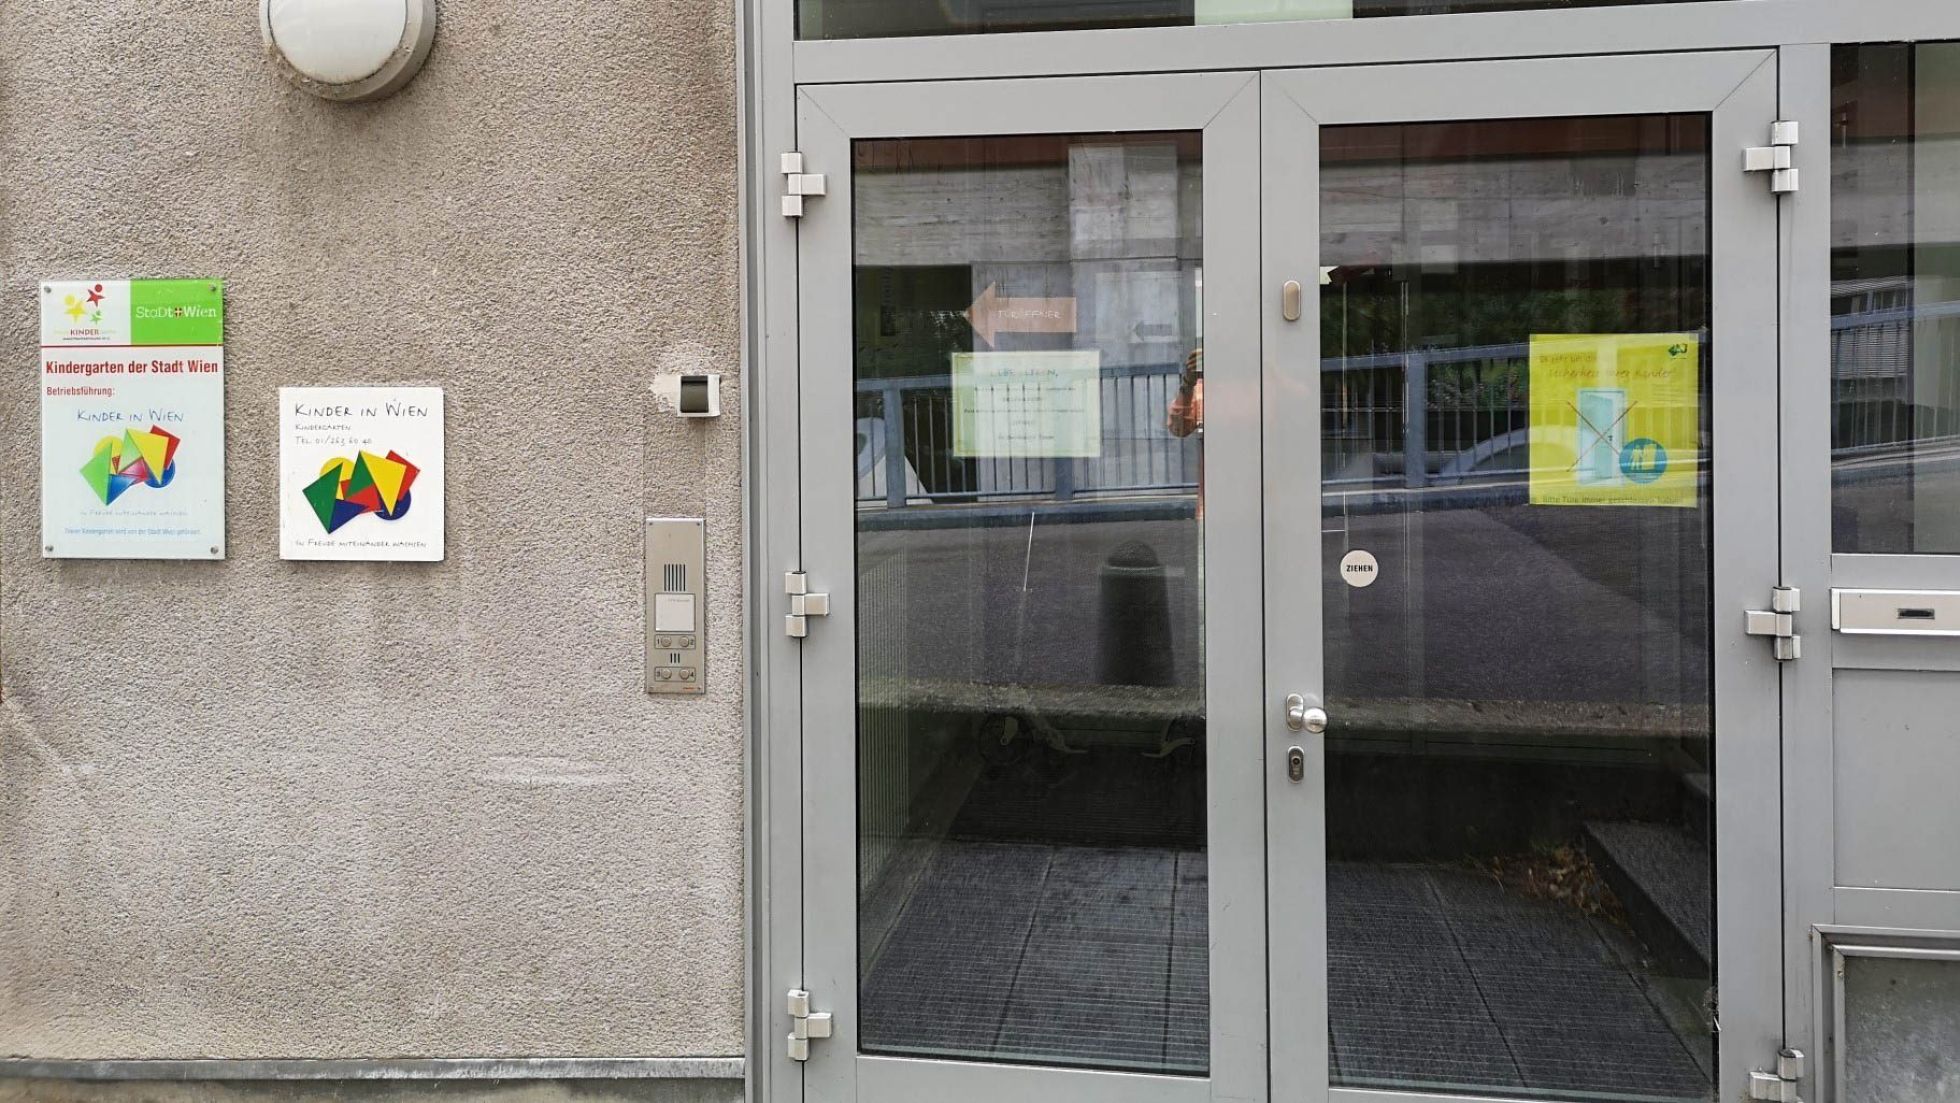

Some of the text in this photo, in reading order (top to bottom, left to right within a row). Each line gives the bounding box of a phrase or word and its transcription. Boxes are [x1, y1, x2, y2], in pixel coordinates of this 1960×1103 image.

[70, 328, 99, 336] KINDER
[46, 360, 218, 376] Kindergarten der Stadt Wien
[47, 386, 115, 397] Betriebsführung:
[1346, 564, 1373, 573] ZIEHEN
